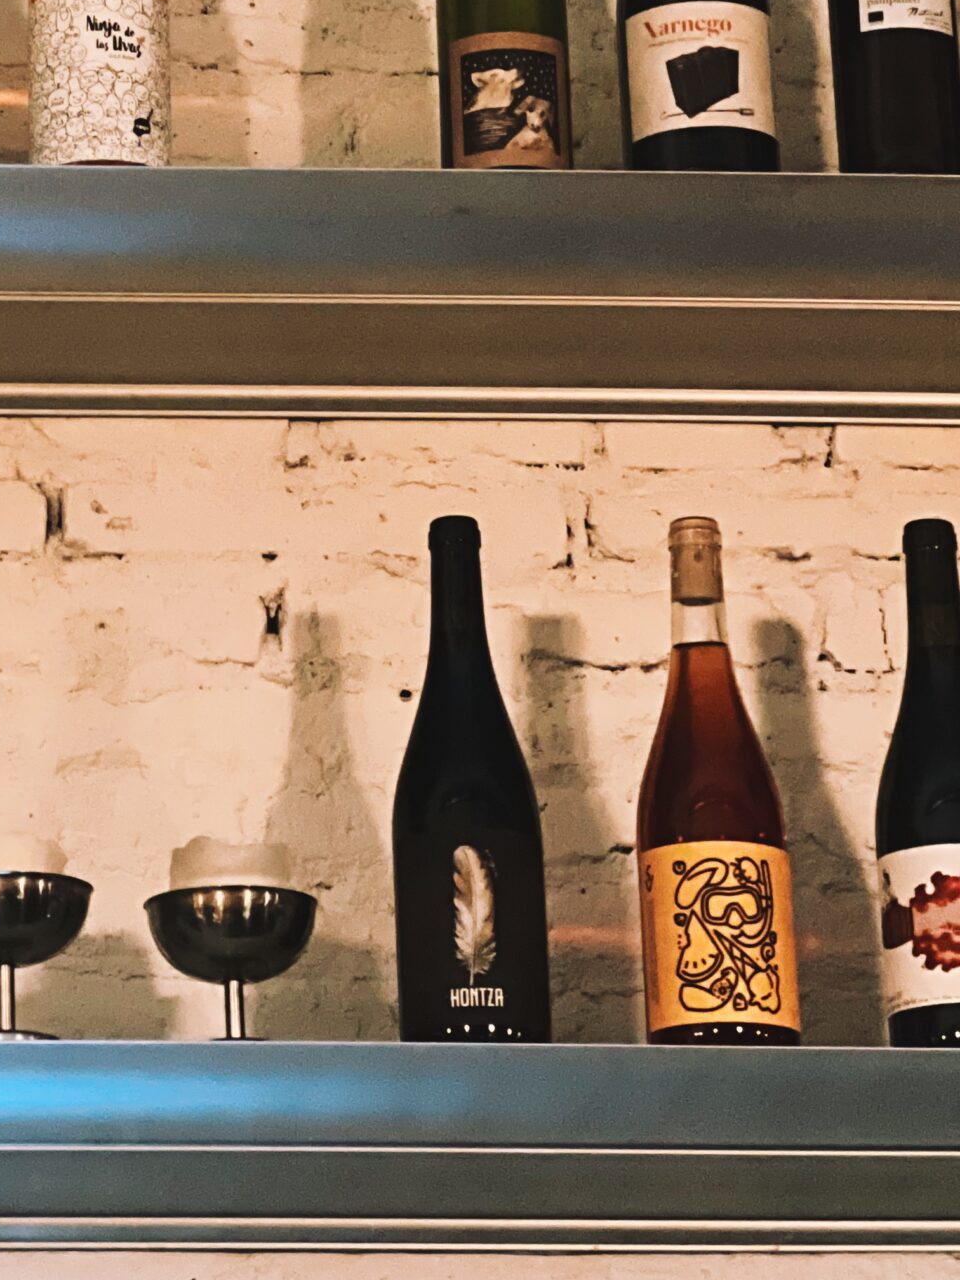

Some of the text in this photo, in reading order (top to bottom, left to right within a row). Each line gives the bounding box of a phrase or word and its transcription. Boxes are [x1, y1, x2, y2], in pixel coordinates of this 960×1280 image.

[86, 15, 135, 38] Ninja de
[644, 19, 732, 38] Varnego
[96, 35, 142, 58] las Uvas
[450, 987, 504, 1008] HONTZA
